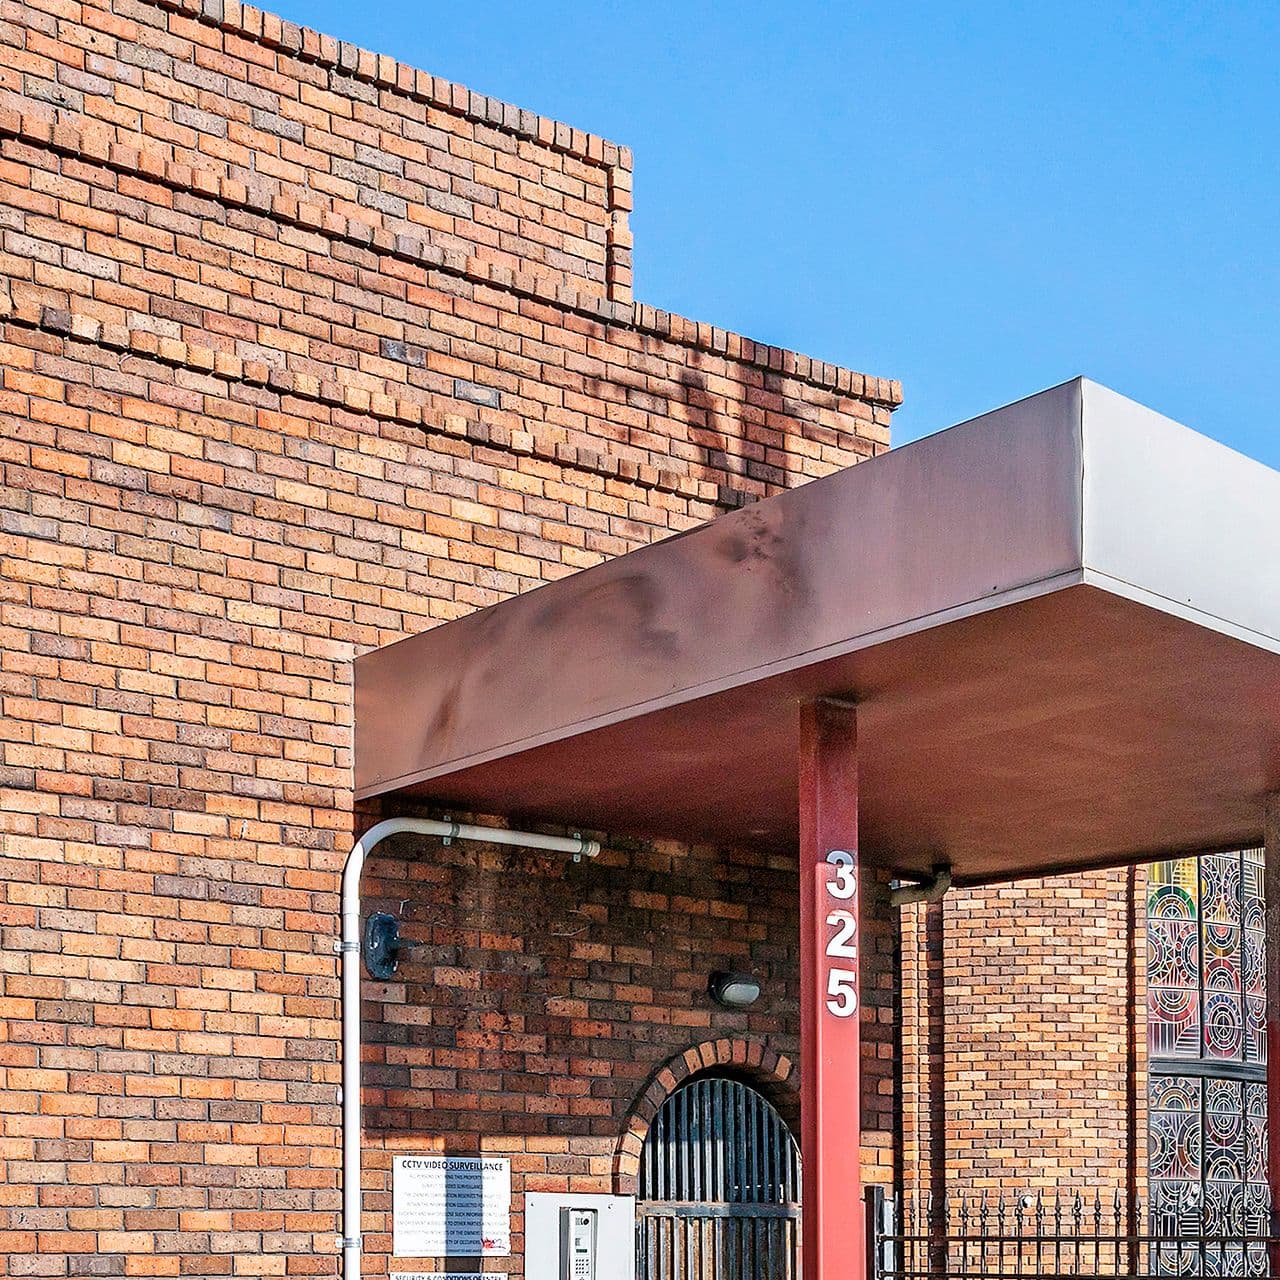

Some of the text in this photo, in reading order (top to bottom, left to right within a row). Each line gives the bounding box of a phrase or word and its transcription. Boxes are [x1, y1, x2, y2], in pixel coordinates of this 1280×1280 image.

[825, 850, 858, 1018] 325
[402, 1160, 503, 1171] CCTV VIDEO SURVEILLANCE
